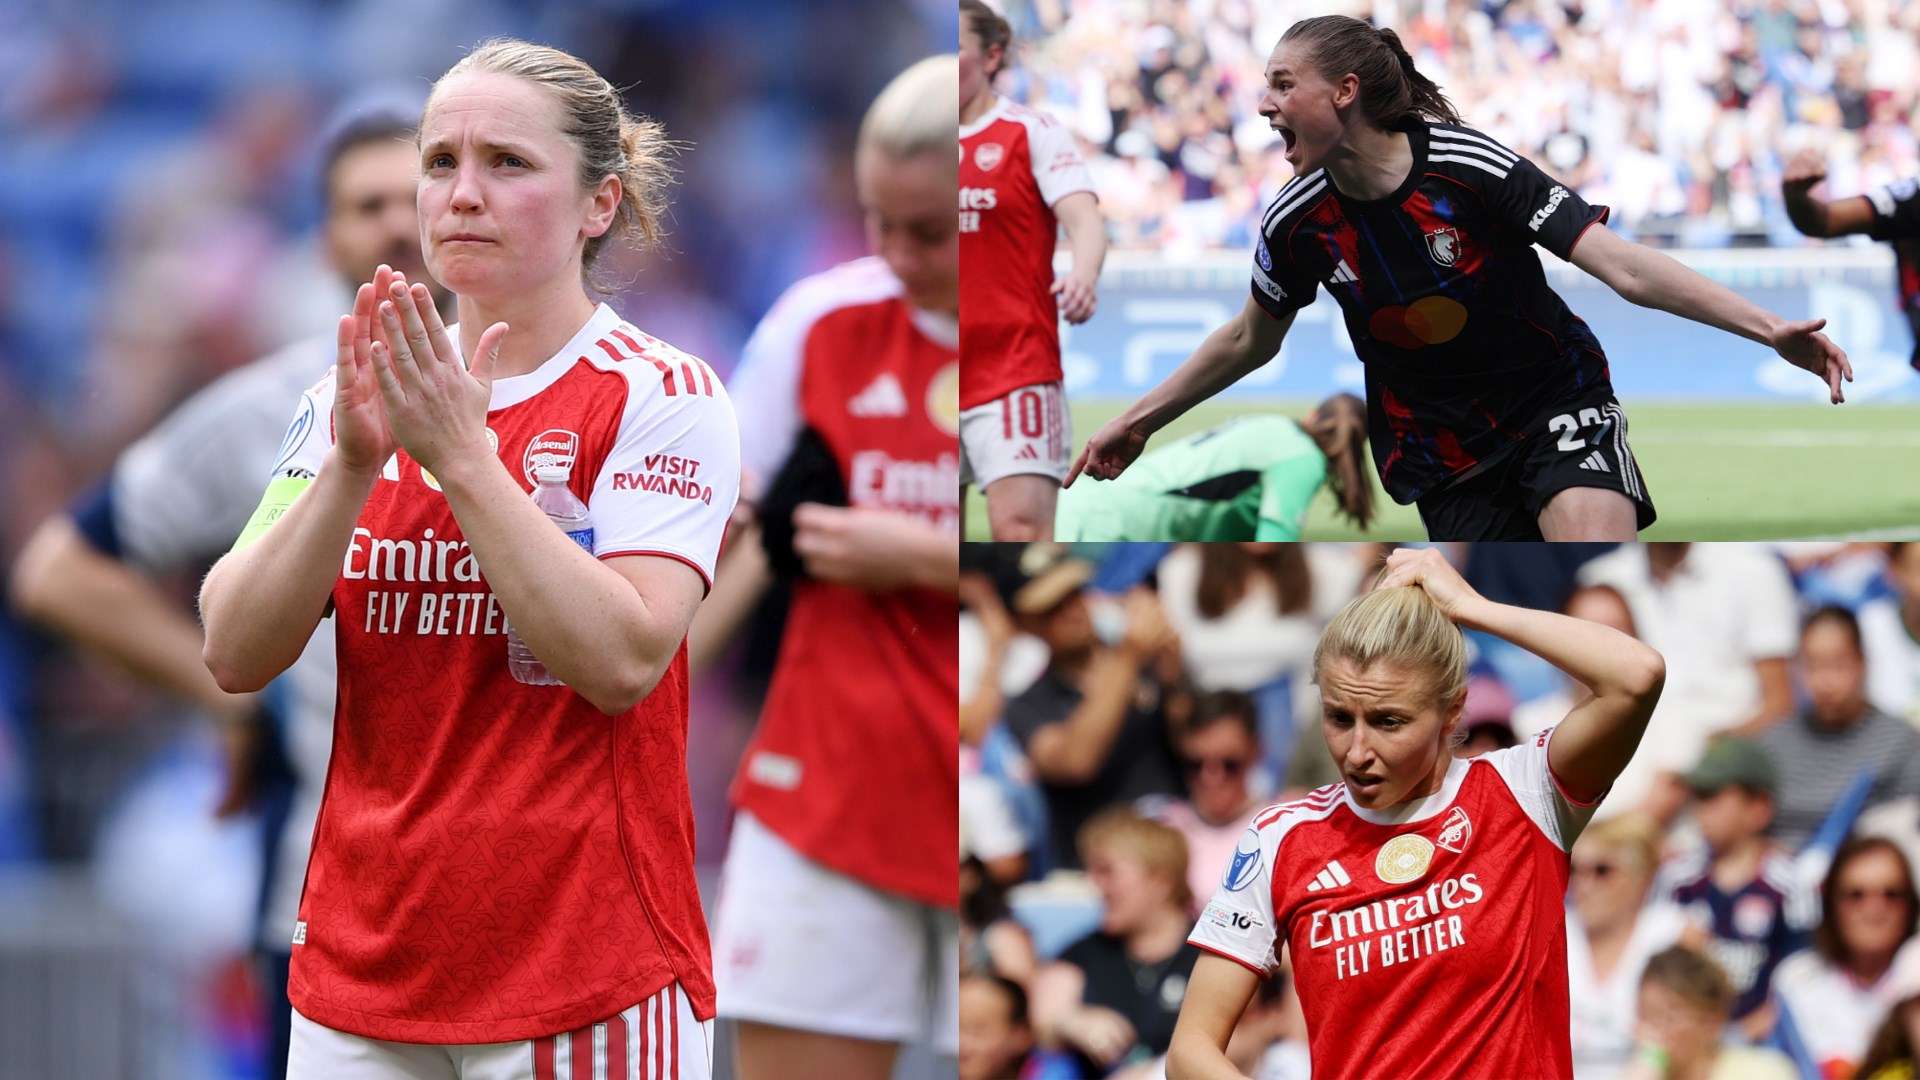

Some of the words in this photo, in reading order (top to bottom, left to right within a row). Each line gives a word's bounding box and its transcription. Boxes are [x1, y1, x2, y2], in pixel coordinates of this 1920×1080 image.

[1002, 391, 1042, 439] 10
[532, 440, 571, 451] Arsenal
[645, 454, 700, 478] VISIT
[612, 472, 713, 506] RWANDA
[364, 590, 410, 635] FLY
[1310, 872, 1484, 950] Emirates
[1335, 939, 1371, 981] FLY
[1380, 914, 1466, 968] BETTER
